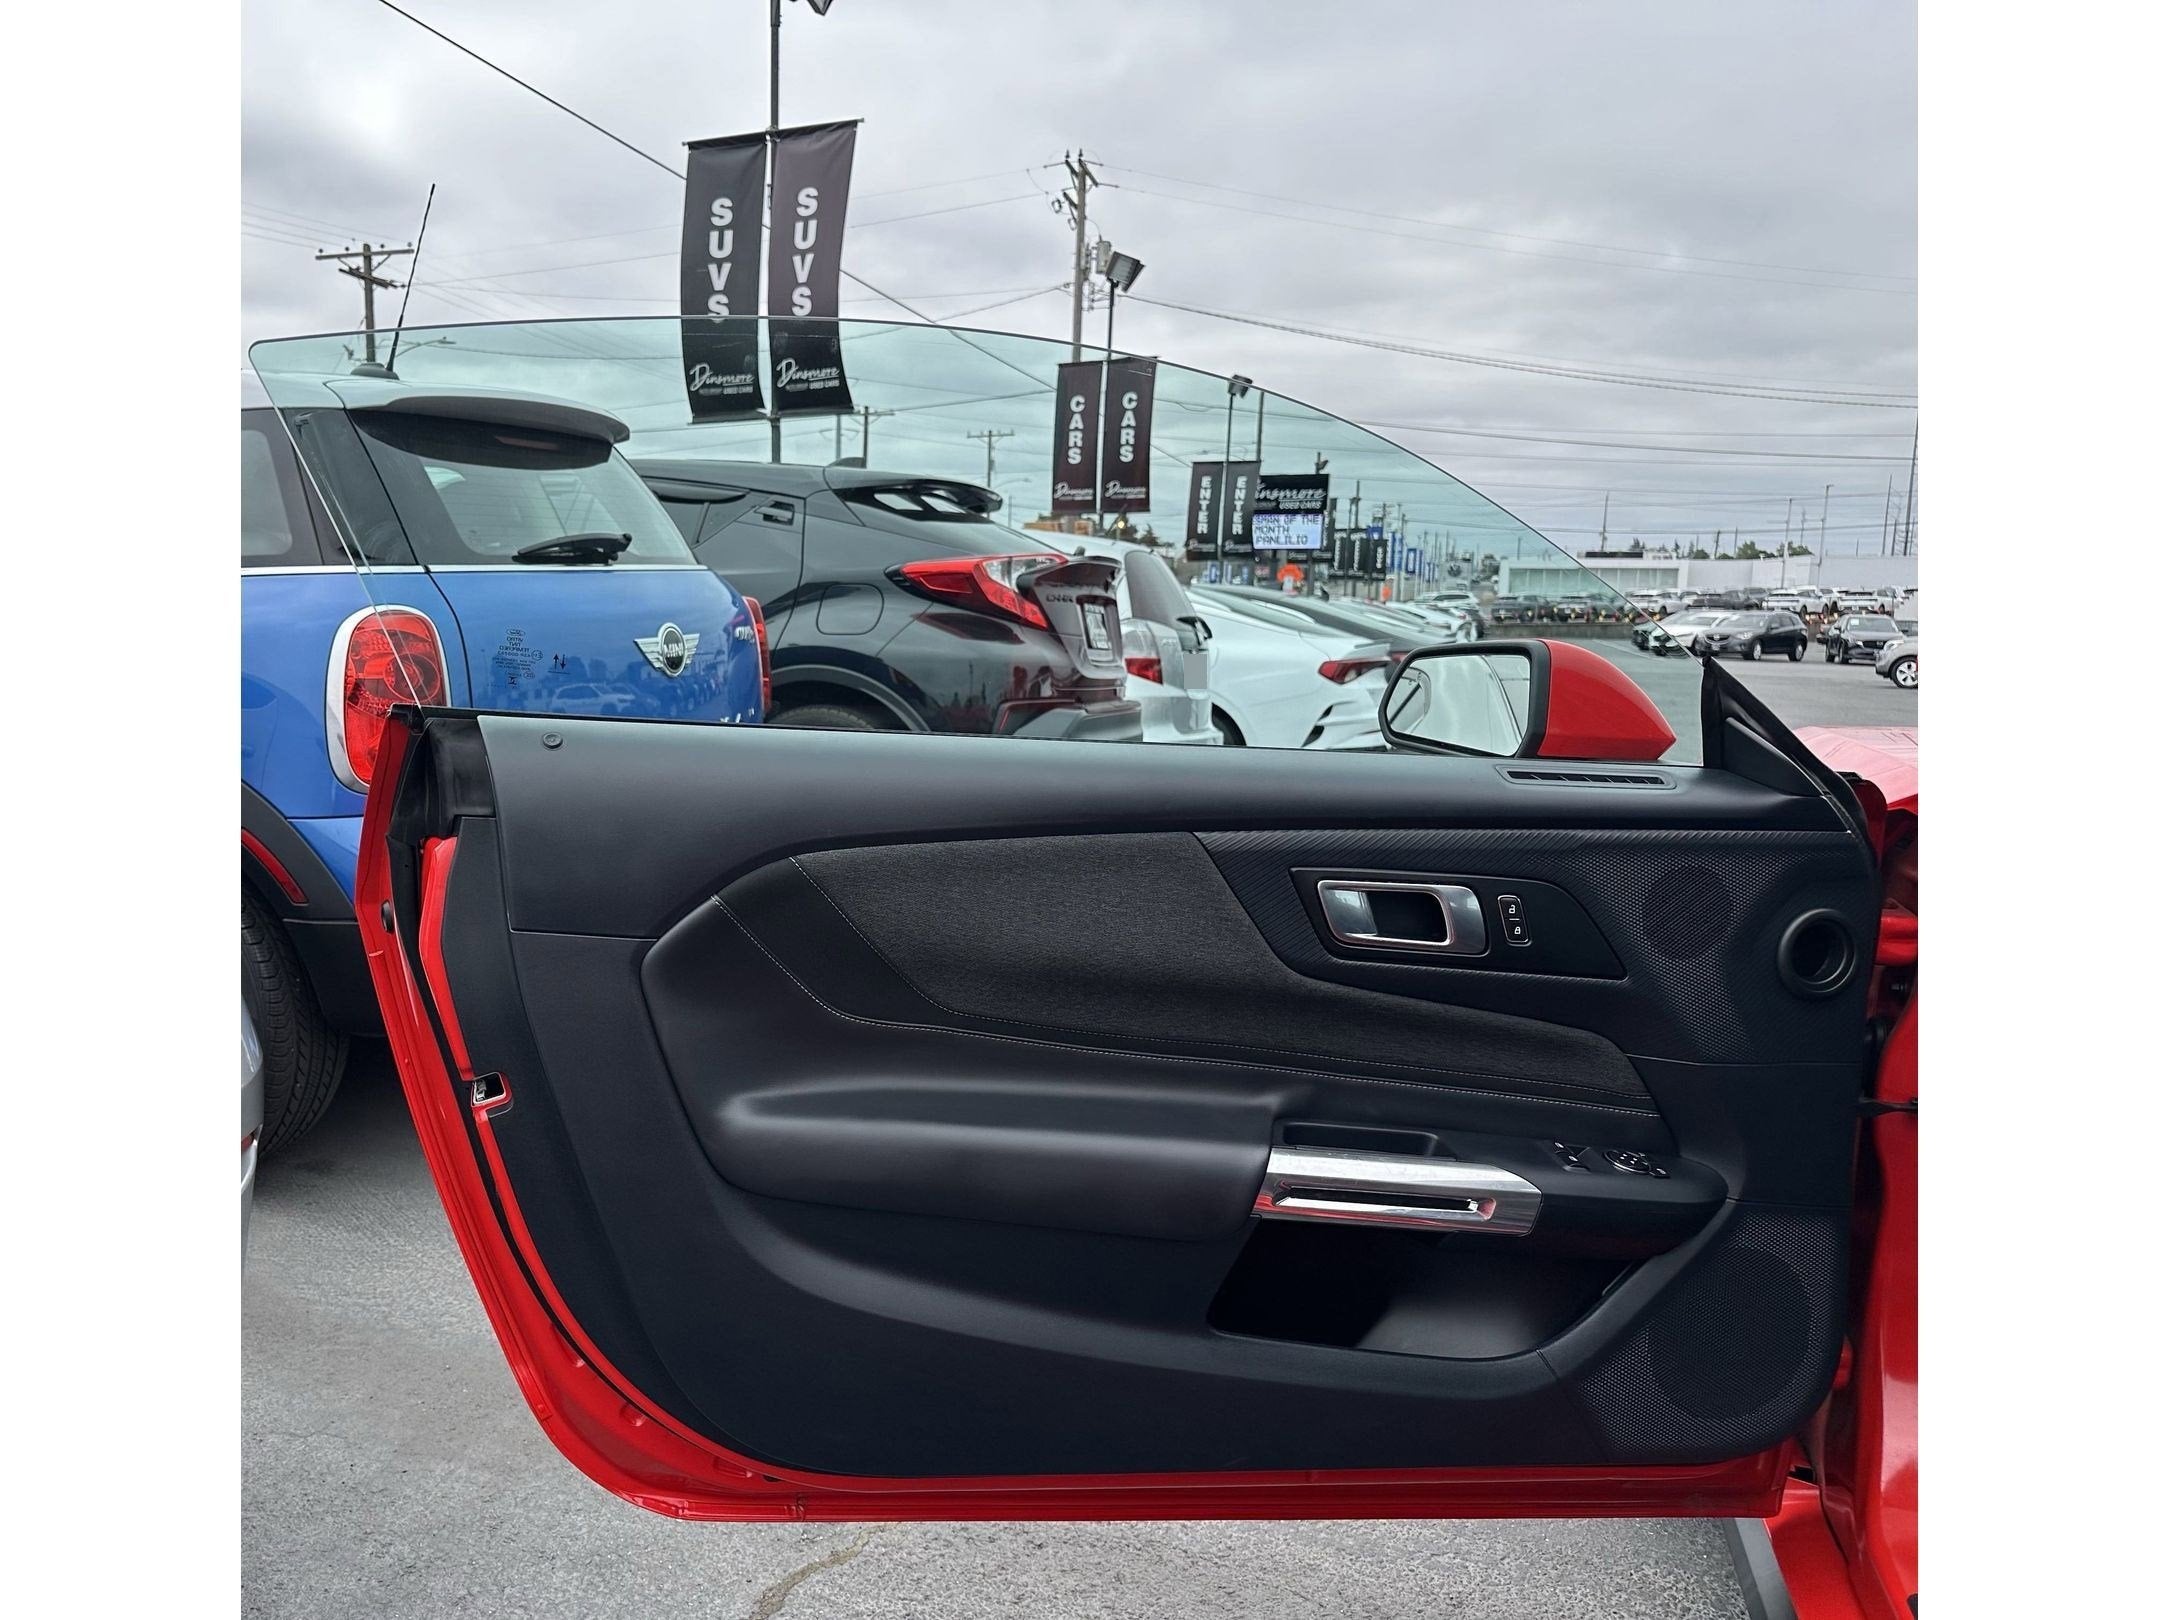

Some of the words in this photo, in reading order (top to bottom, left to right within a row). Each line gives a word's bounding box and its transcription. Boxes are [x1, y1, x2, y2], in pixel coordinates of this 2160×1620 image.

[707, 198, 734, 323] SUVS
[791, 187, 819, 317] SUVS
[689, 363, 755, 391] Dinsmore
[776, 358, 840, 388] Dinsmore
[1067, 395, 1086, 465] CARS
[1119, 391, 1138, 463] CARS
[1197, 476, 1212, 534] ENTER
[1232, 476, 1248, 535] ENTER
[1254, 478, 1327, 500] insmore
[1254, 525, 1289, 536] MONTH
[1283, 514, 1297, 525] OF
[664, 642, 684, 658] MINI
